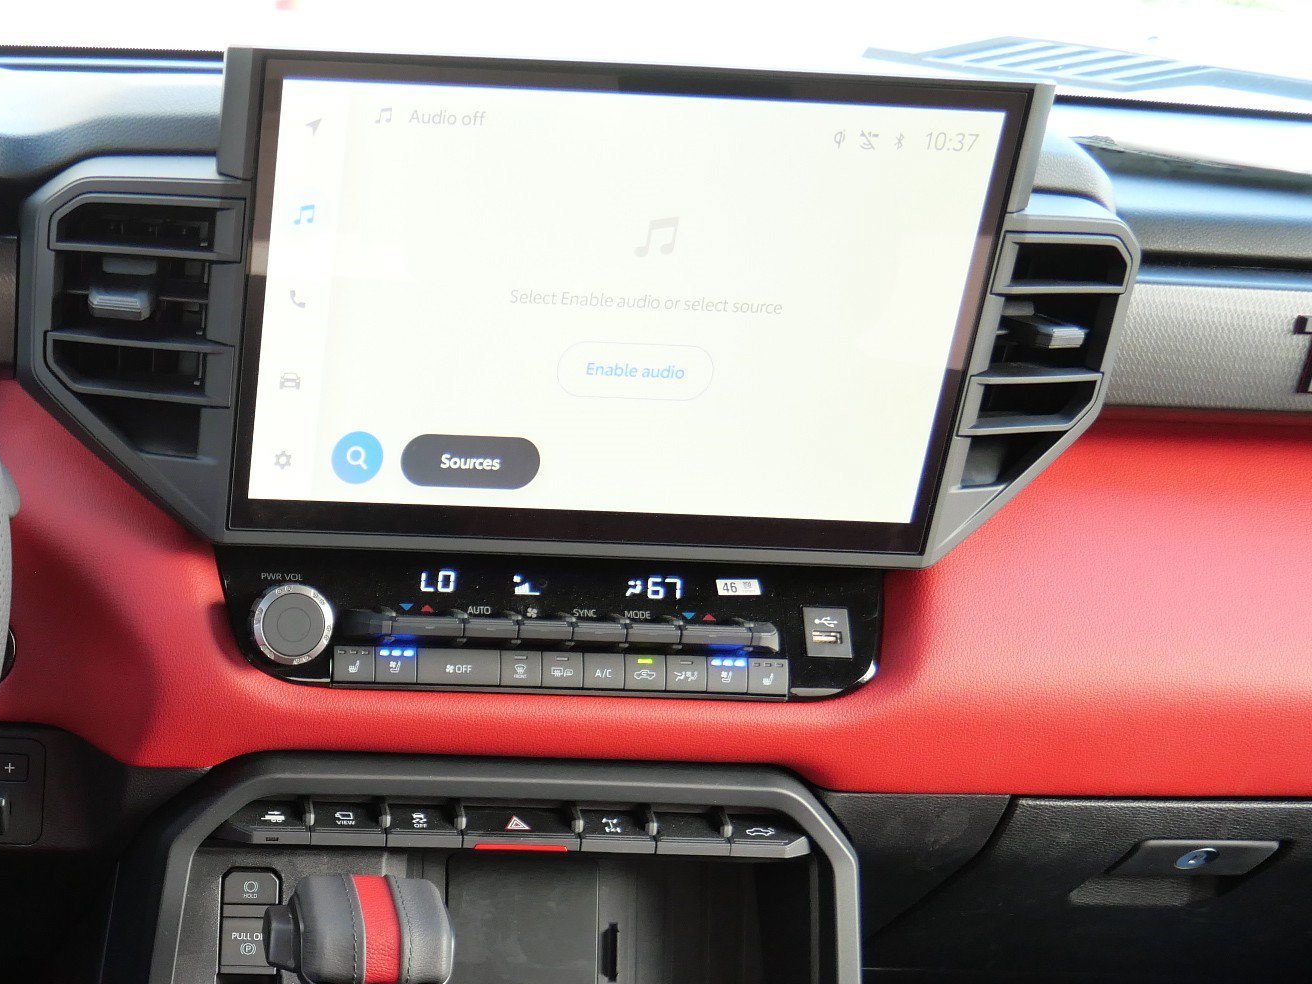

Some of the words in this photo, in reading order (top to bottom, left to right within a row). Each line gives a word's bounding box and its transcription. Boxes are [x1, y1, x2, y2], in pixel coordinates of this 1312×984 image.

[408, 109, 457, 125] Audio
[461, 110, 486, 126] off
[925, 131, 979, 152] 10:37
[510, 289, 557, 305] Select
[561, 291, 614, 308] Enable
[617, 294, 661, 310] audio
[664, 299, 680, 310] or
[683, 296, 729, 313] select
[732, 301, 783, 315] source
[586, 362, 638, 378] Enable
[641, 364, 685, 380] audio
[440, 453, 500, 471] Sources
[261, 572, 283, 580] PWR
[284, 573, 303, 581] VOL
[647, 577, 682, 600] 67
[722, 582, 738, 593] 46
[467, 605, 491, 615] AUTO
[573, 608, 597, 618] SYNC
[624, 610, 651, 620] MODE
[455, 664, 472, 674] OFF
[595, 668, 612, 678] A/C
[231, 932, 251, 940] PULL
